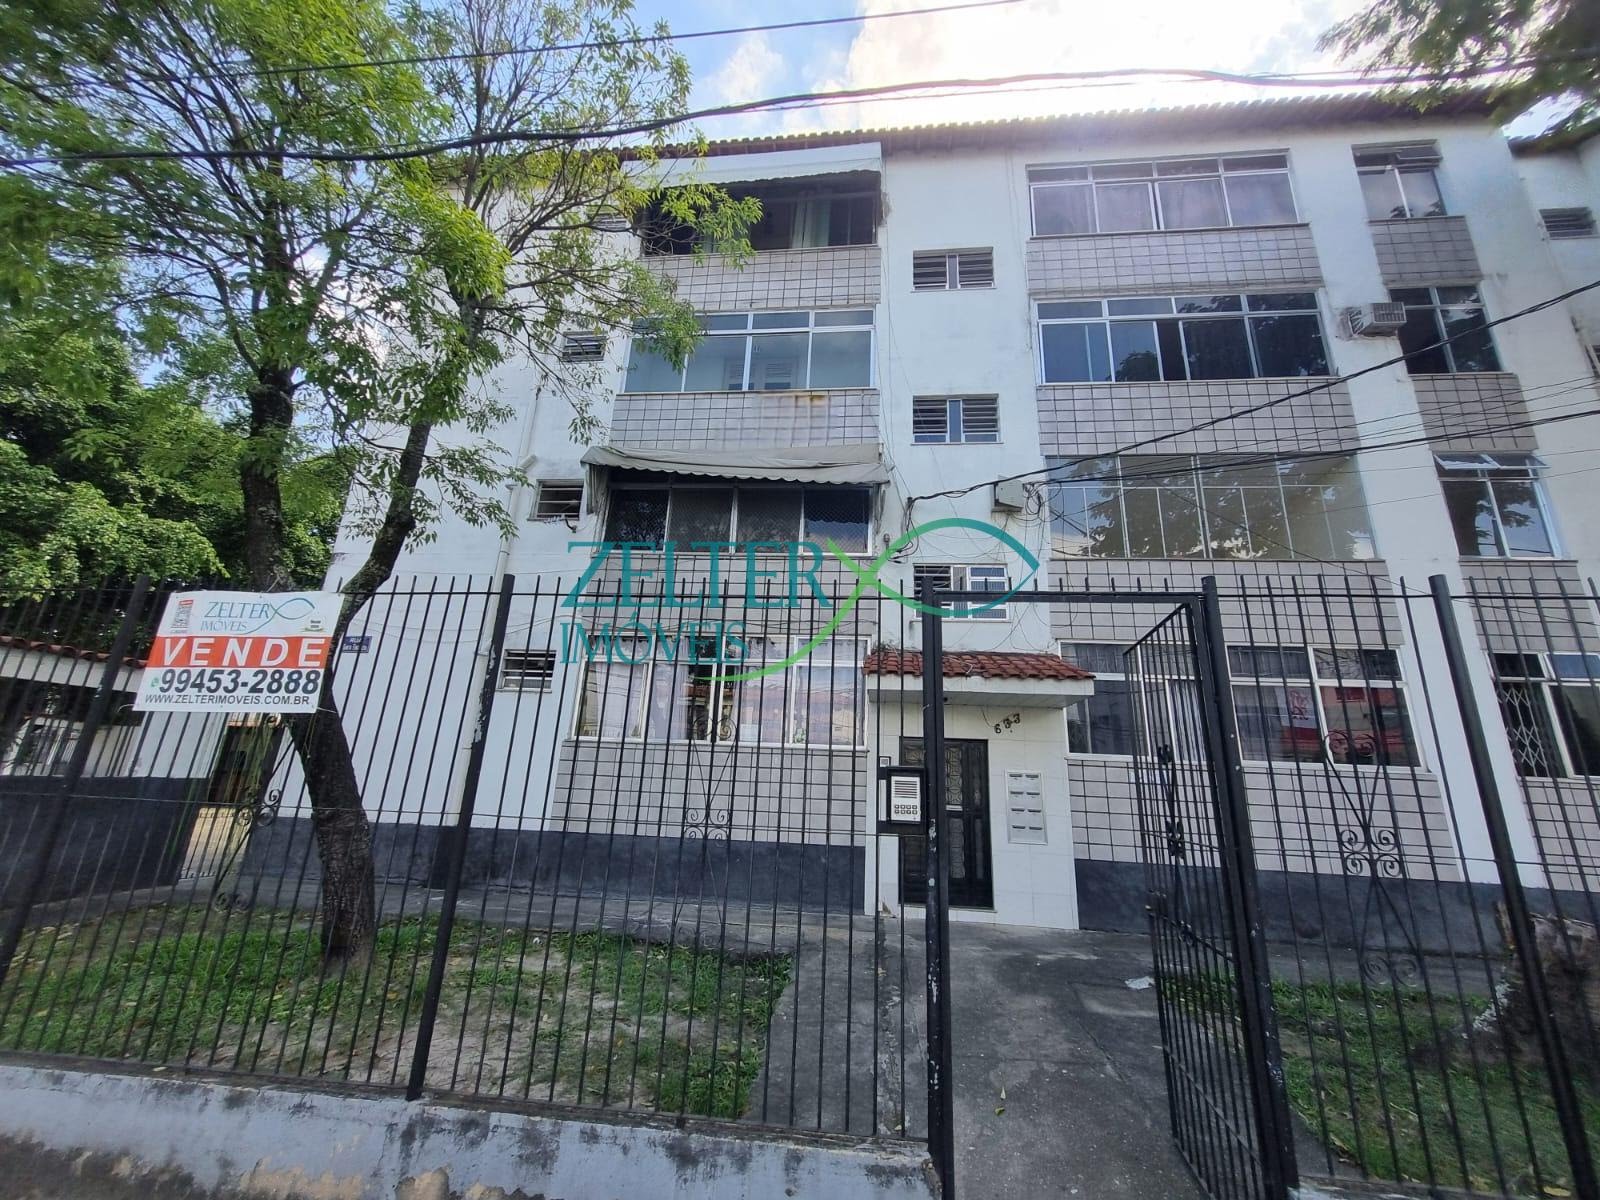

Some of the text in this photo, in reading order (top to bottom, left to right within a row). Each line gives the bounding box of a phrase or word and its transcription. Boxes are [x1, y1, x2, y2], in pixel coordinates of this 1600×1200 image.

[204, 600, 270, 620] ZELTER
[200, 619, 248, 632] IMÓVEIS
[162, 637, 326, 667] VENDE
[158, 669, 321, 695] 99453-2888
[145, 694, 310, 705] WWW.ZELTERIMOVEIS.COM.BR
